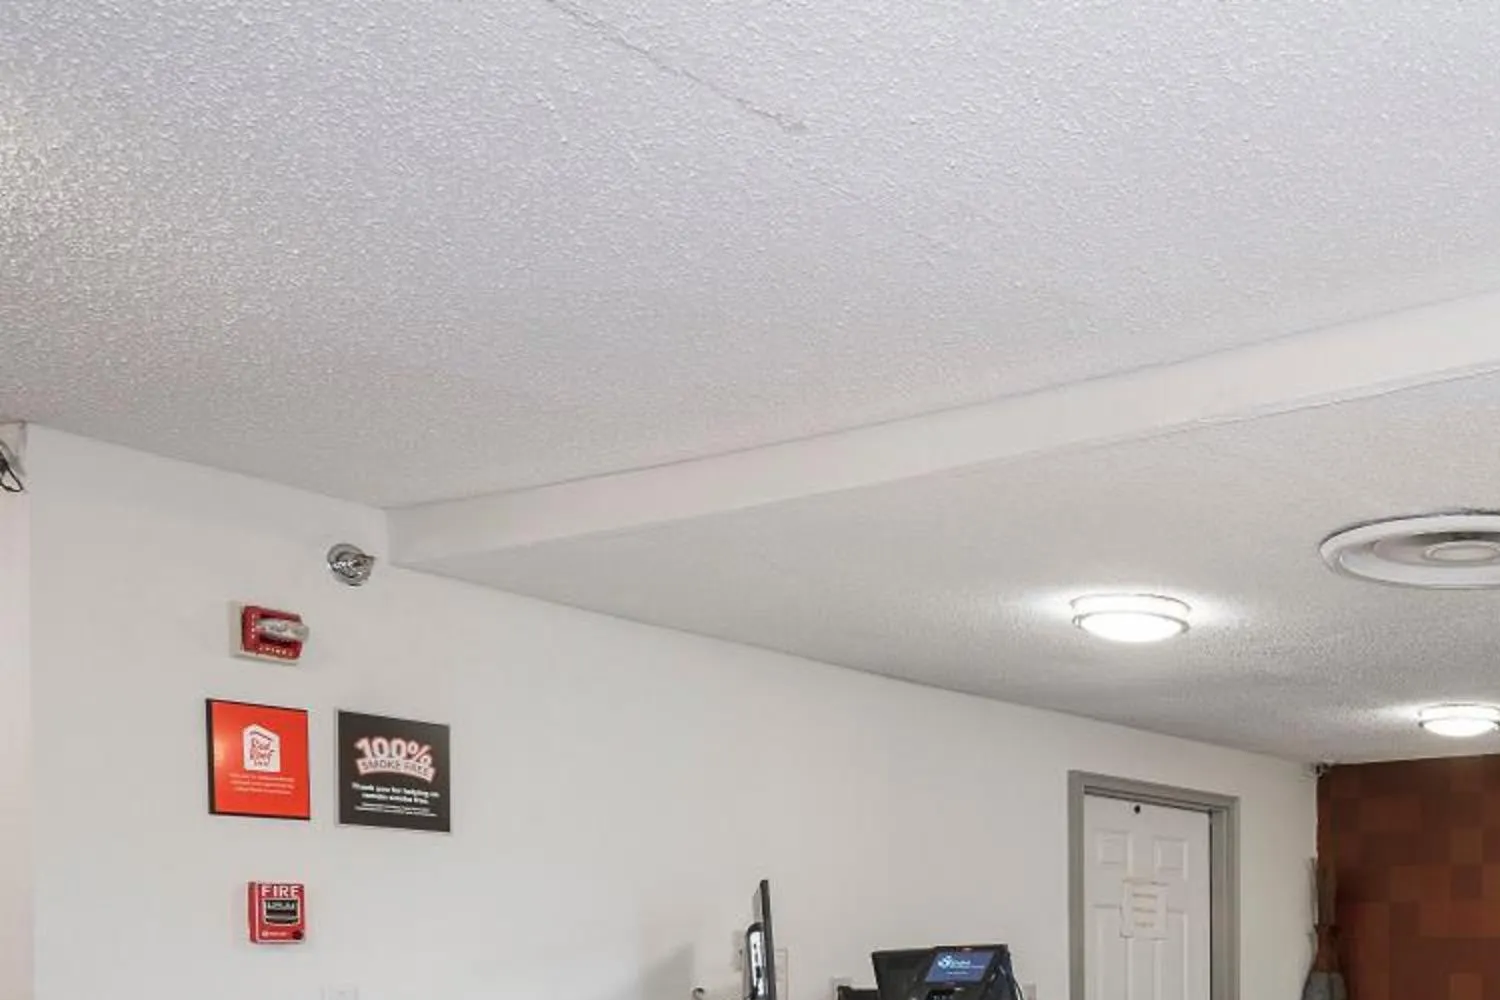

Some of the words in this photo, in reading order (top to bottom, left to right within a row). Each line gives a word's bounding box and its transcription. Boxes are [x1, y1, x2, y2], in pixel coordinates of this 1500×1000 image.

[354, 736, 433, 766] 100%
[361, 759, 401, 772] SMOKE
[403, 761, 432, 777] FREE
[261, 885, 299, 897] FIRE
